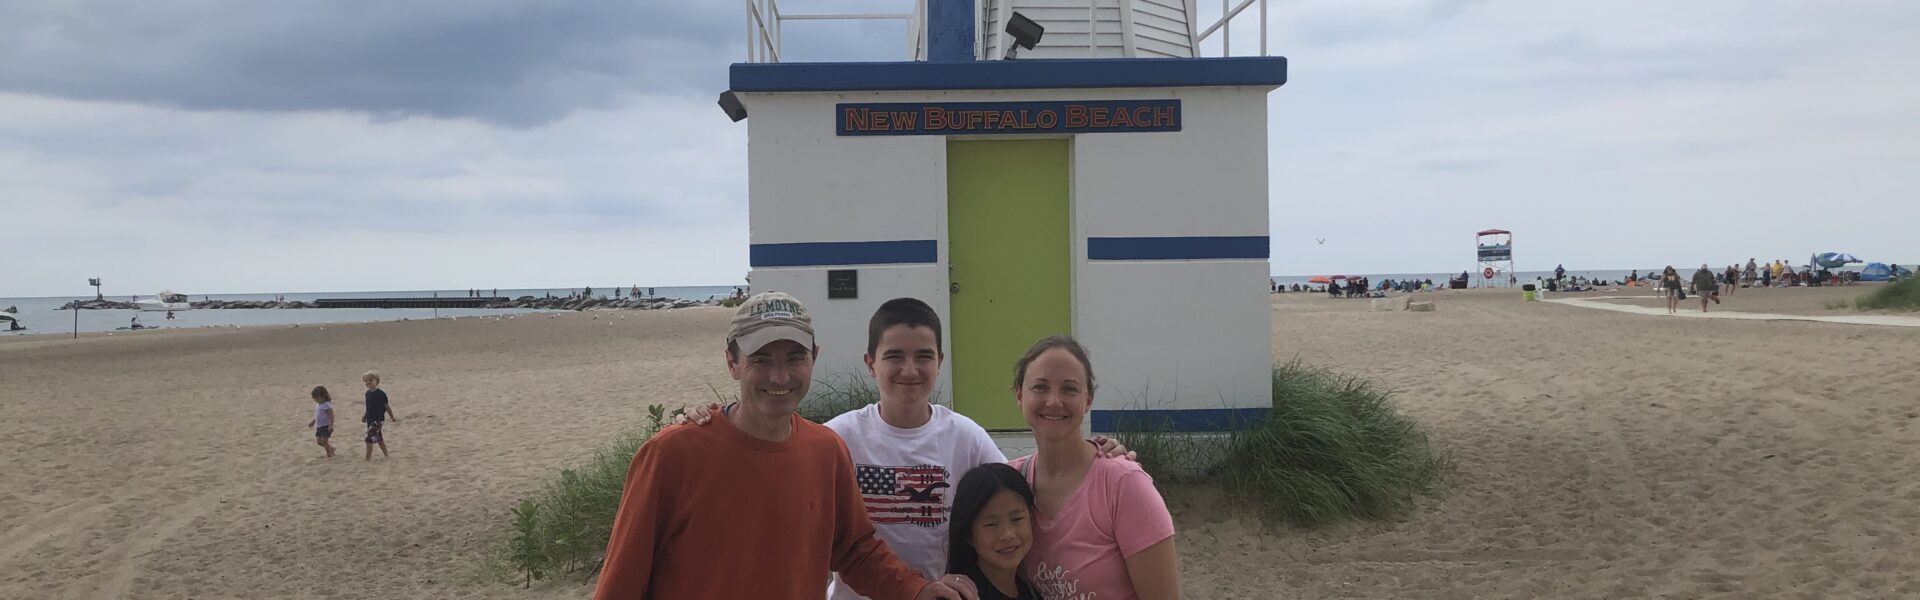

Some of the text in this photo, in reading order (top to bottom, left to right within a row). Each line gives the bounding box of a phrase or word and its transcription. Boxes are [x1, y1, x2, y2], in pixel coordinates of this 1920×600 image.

[845, 104, 1176, 131] NEW BUFFALO BEACH
[749, 299, 801, 316] LE MOYNE
